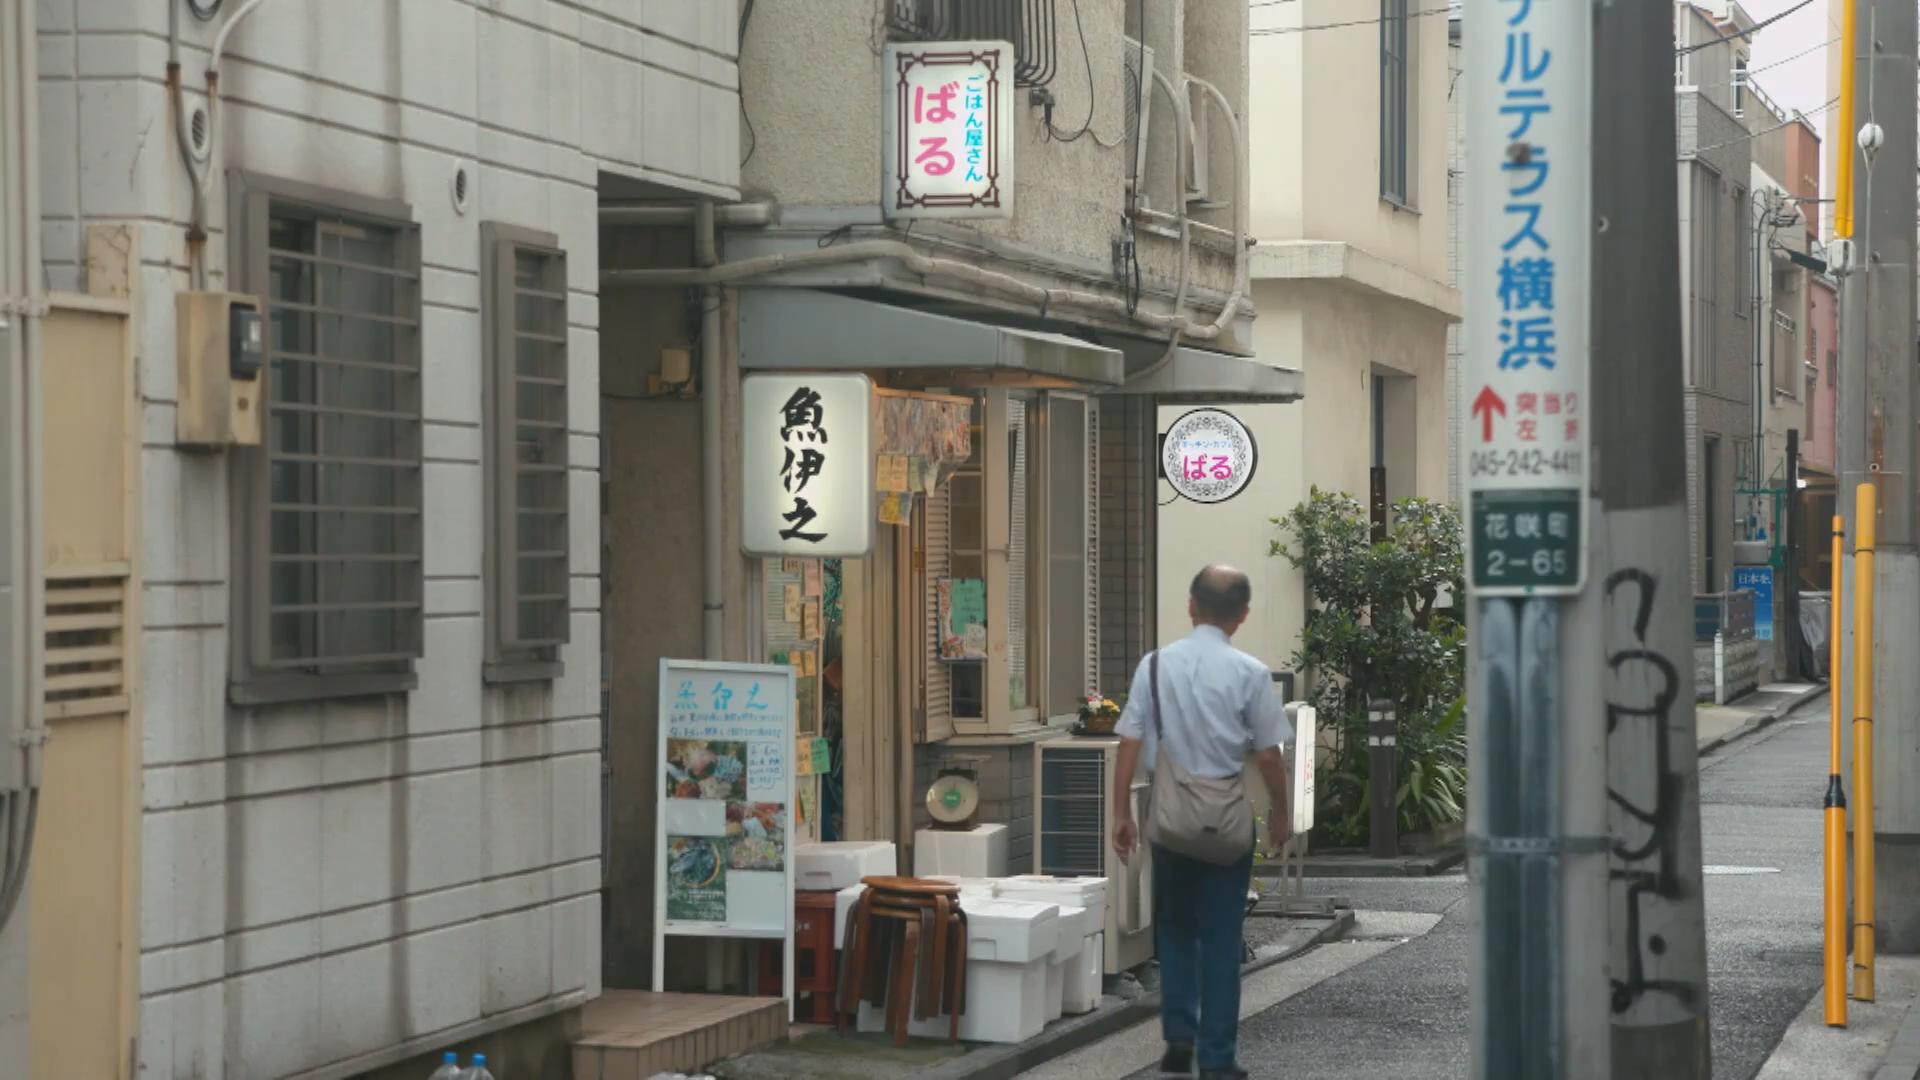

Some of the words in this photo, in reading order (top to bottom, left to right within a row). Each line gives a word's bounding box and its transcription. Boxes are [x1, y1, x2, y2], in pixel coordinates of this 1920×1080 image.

[914, 81, 960, 177] ばる
[965, 74, 984, 182] ごはん屋さん
[779, 386, 828, 544] 魚伊之
[1183, 453, 1232, 480] ばる
[1485, 512, 1570, 539] 花咲町
[1487, 548, 1568, 576] 2-65
